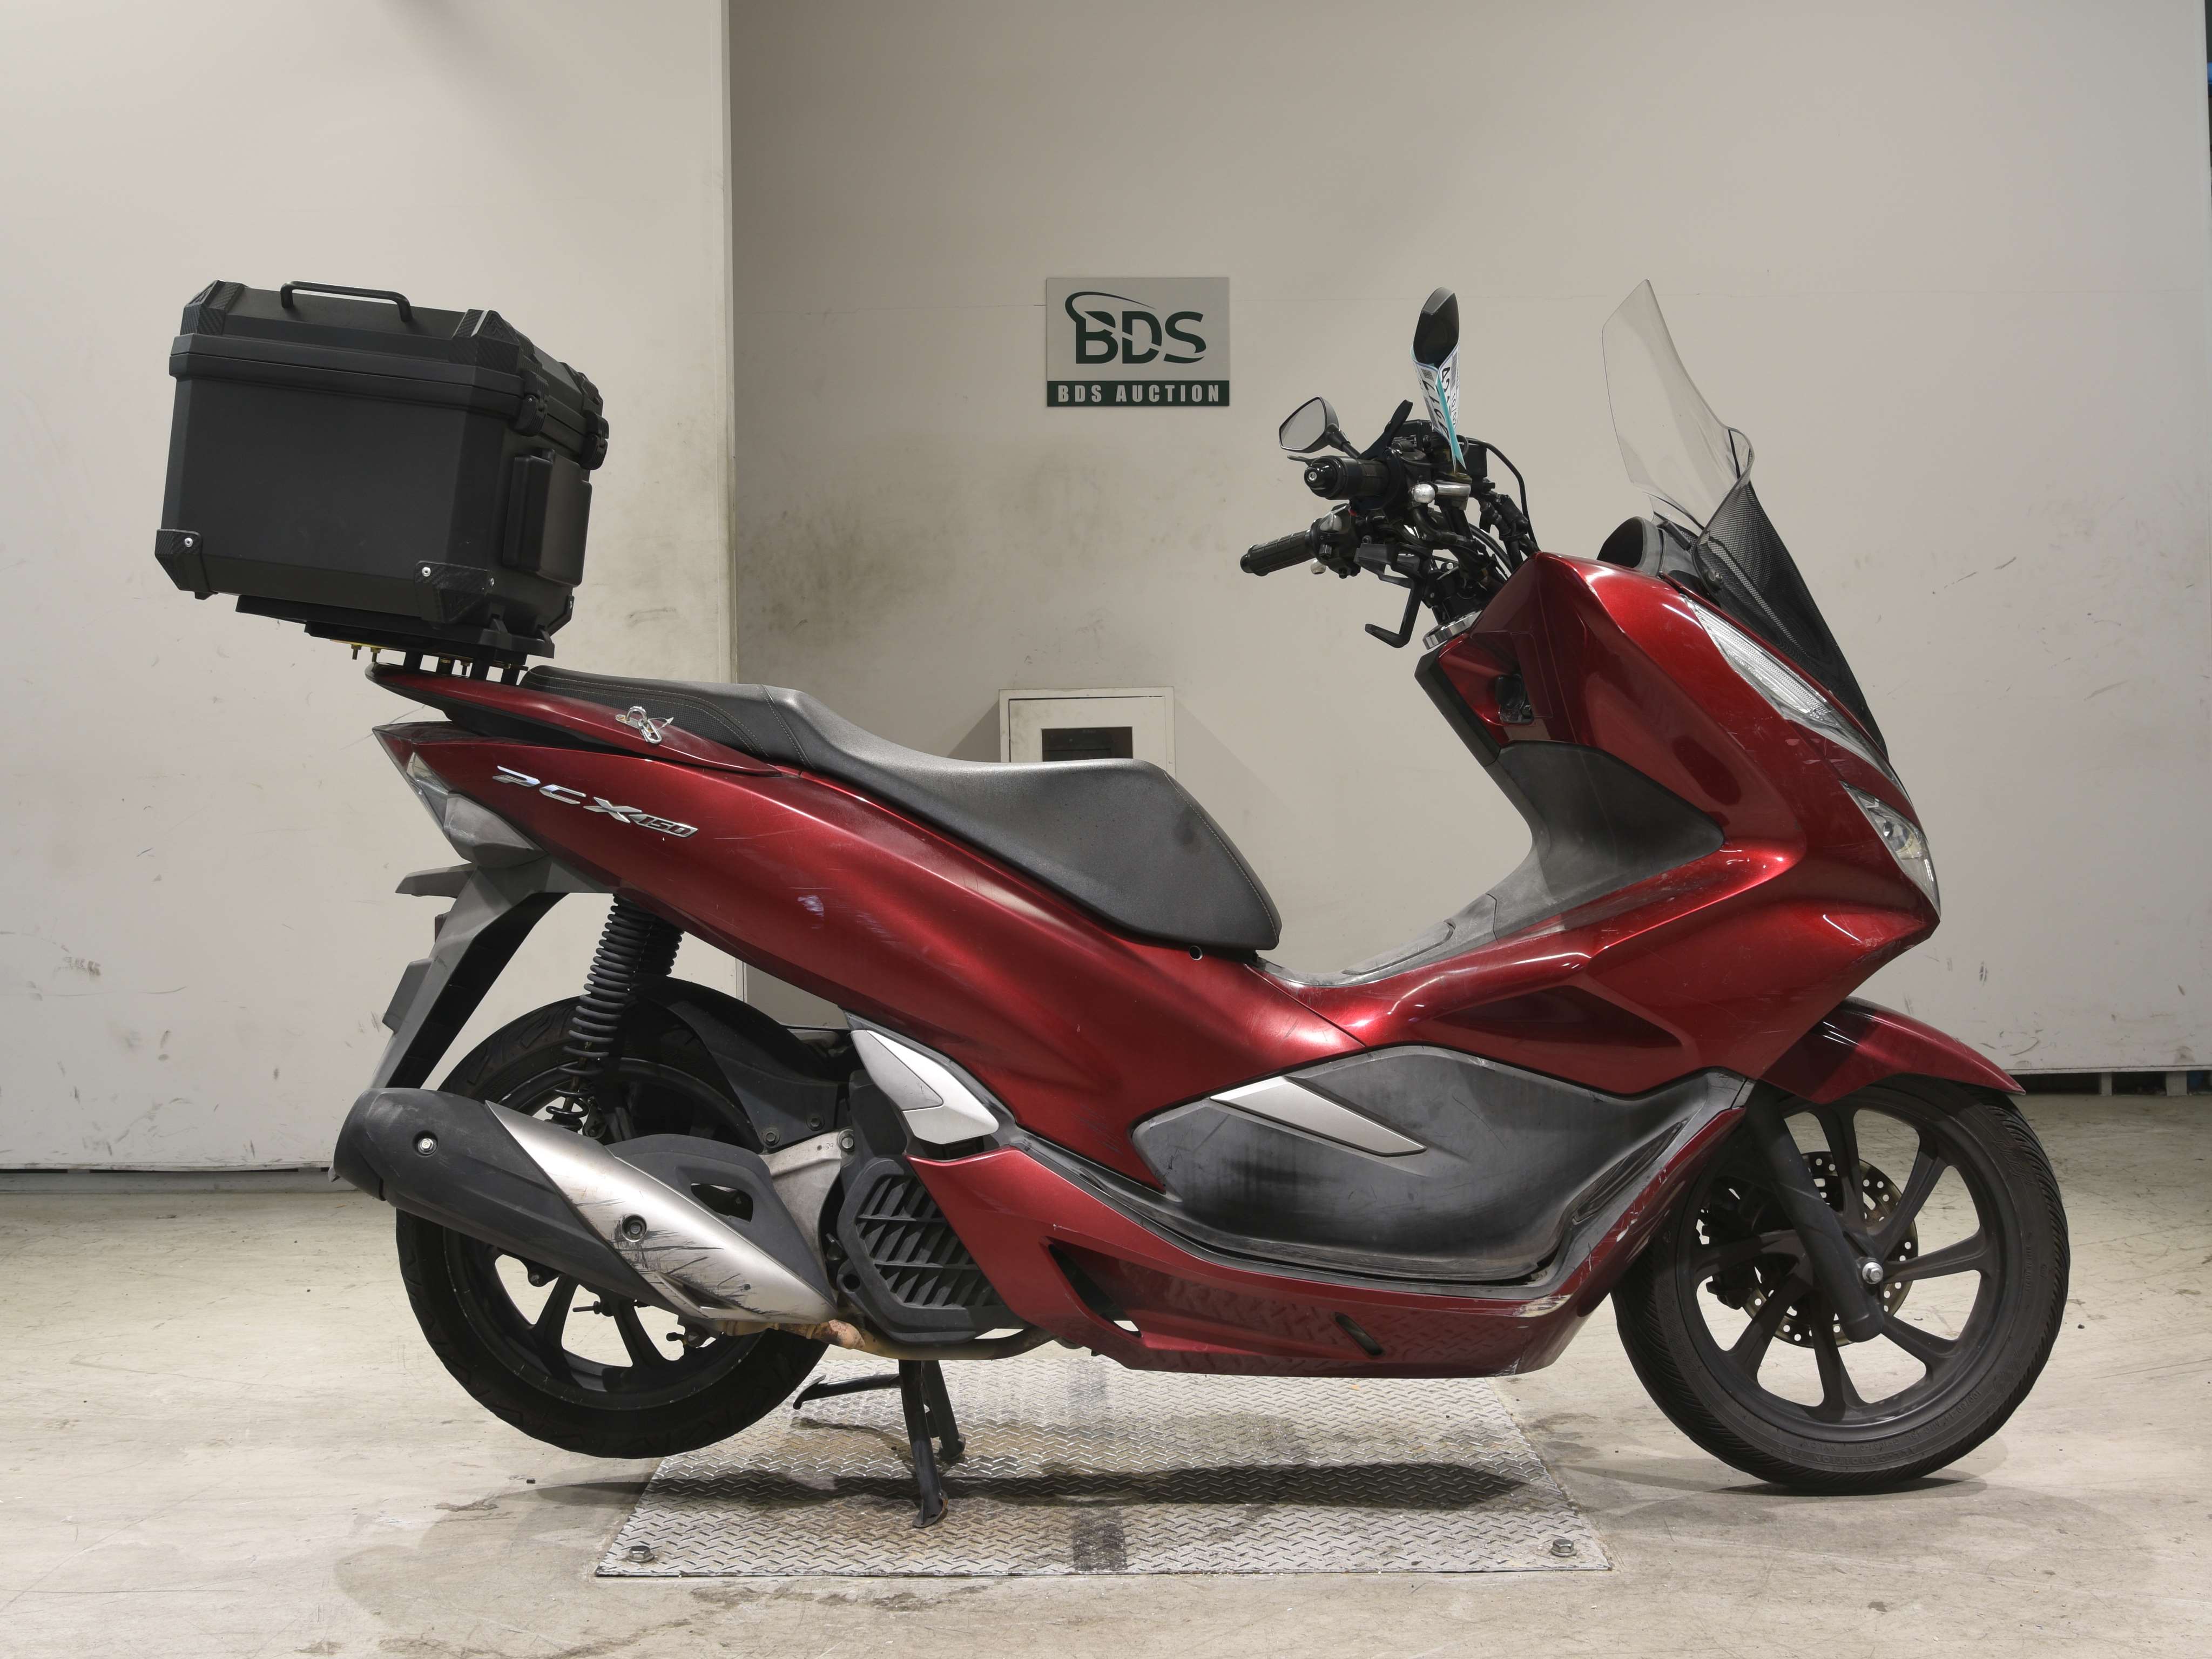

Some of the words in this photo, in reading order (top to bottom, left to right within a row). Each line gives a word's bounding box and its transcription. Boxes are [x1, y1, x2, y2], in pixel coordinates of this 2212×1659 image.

[1065, 292, 1206, 364] BDS
[1058, 385, 1102, 402] BDS
[1116, 385, 1219, 402] AUCTION
[493, 765, 642, 824] PCX
